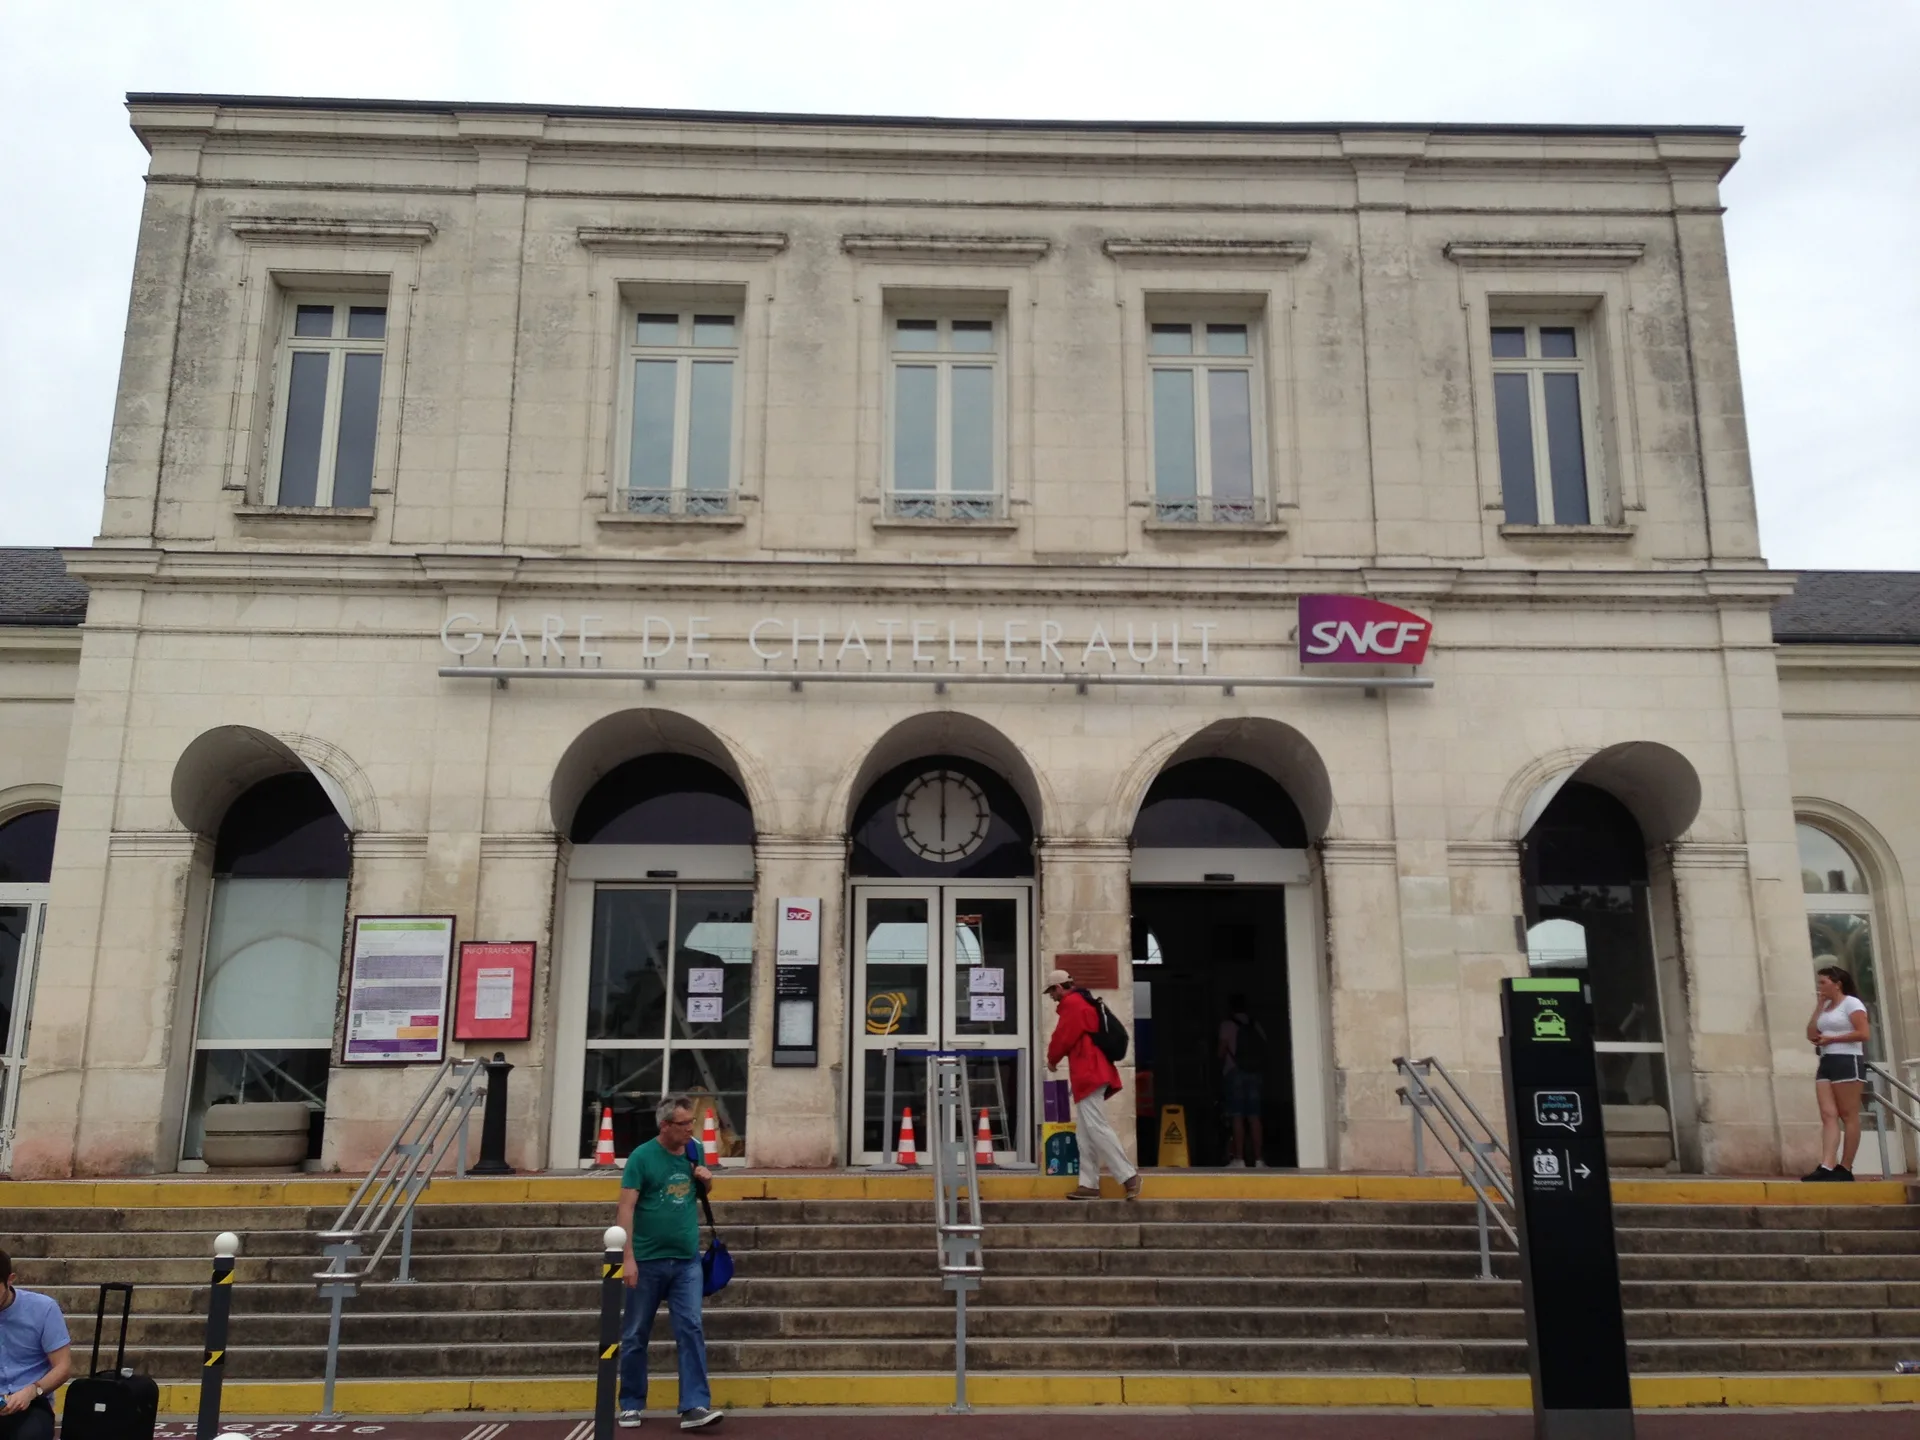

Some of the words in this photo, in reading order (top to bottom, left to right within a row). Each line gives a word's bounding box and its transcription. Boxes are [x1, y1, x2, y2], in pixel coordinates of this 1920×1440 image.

[441, 612, 603, 657] GARE
[643, 615, 711, 659] DE
[749, 617, 1218, 665] CHATELLERAULT
[1305, 621, 1426, 655] SNCF
[787, 912, 811, 920] SNCF
[463, 947, 484, 955] INFO
[484, 947, 510, 955] TRAFIC
[511, 946, 531, 955] SNCF
[1537, 997, 1559, 1006] Taxis
